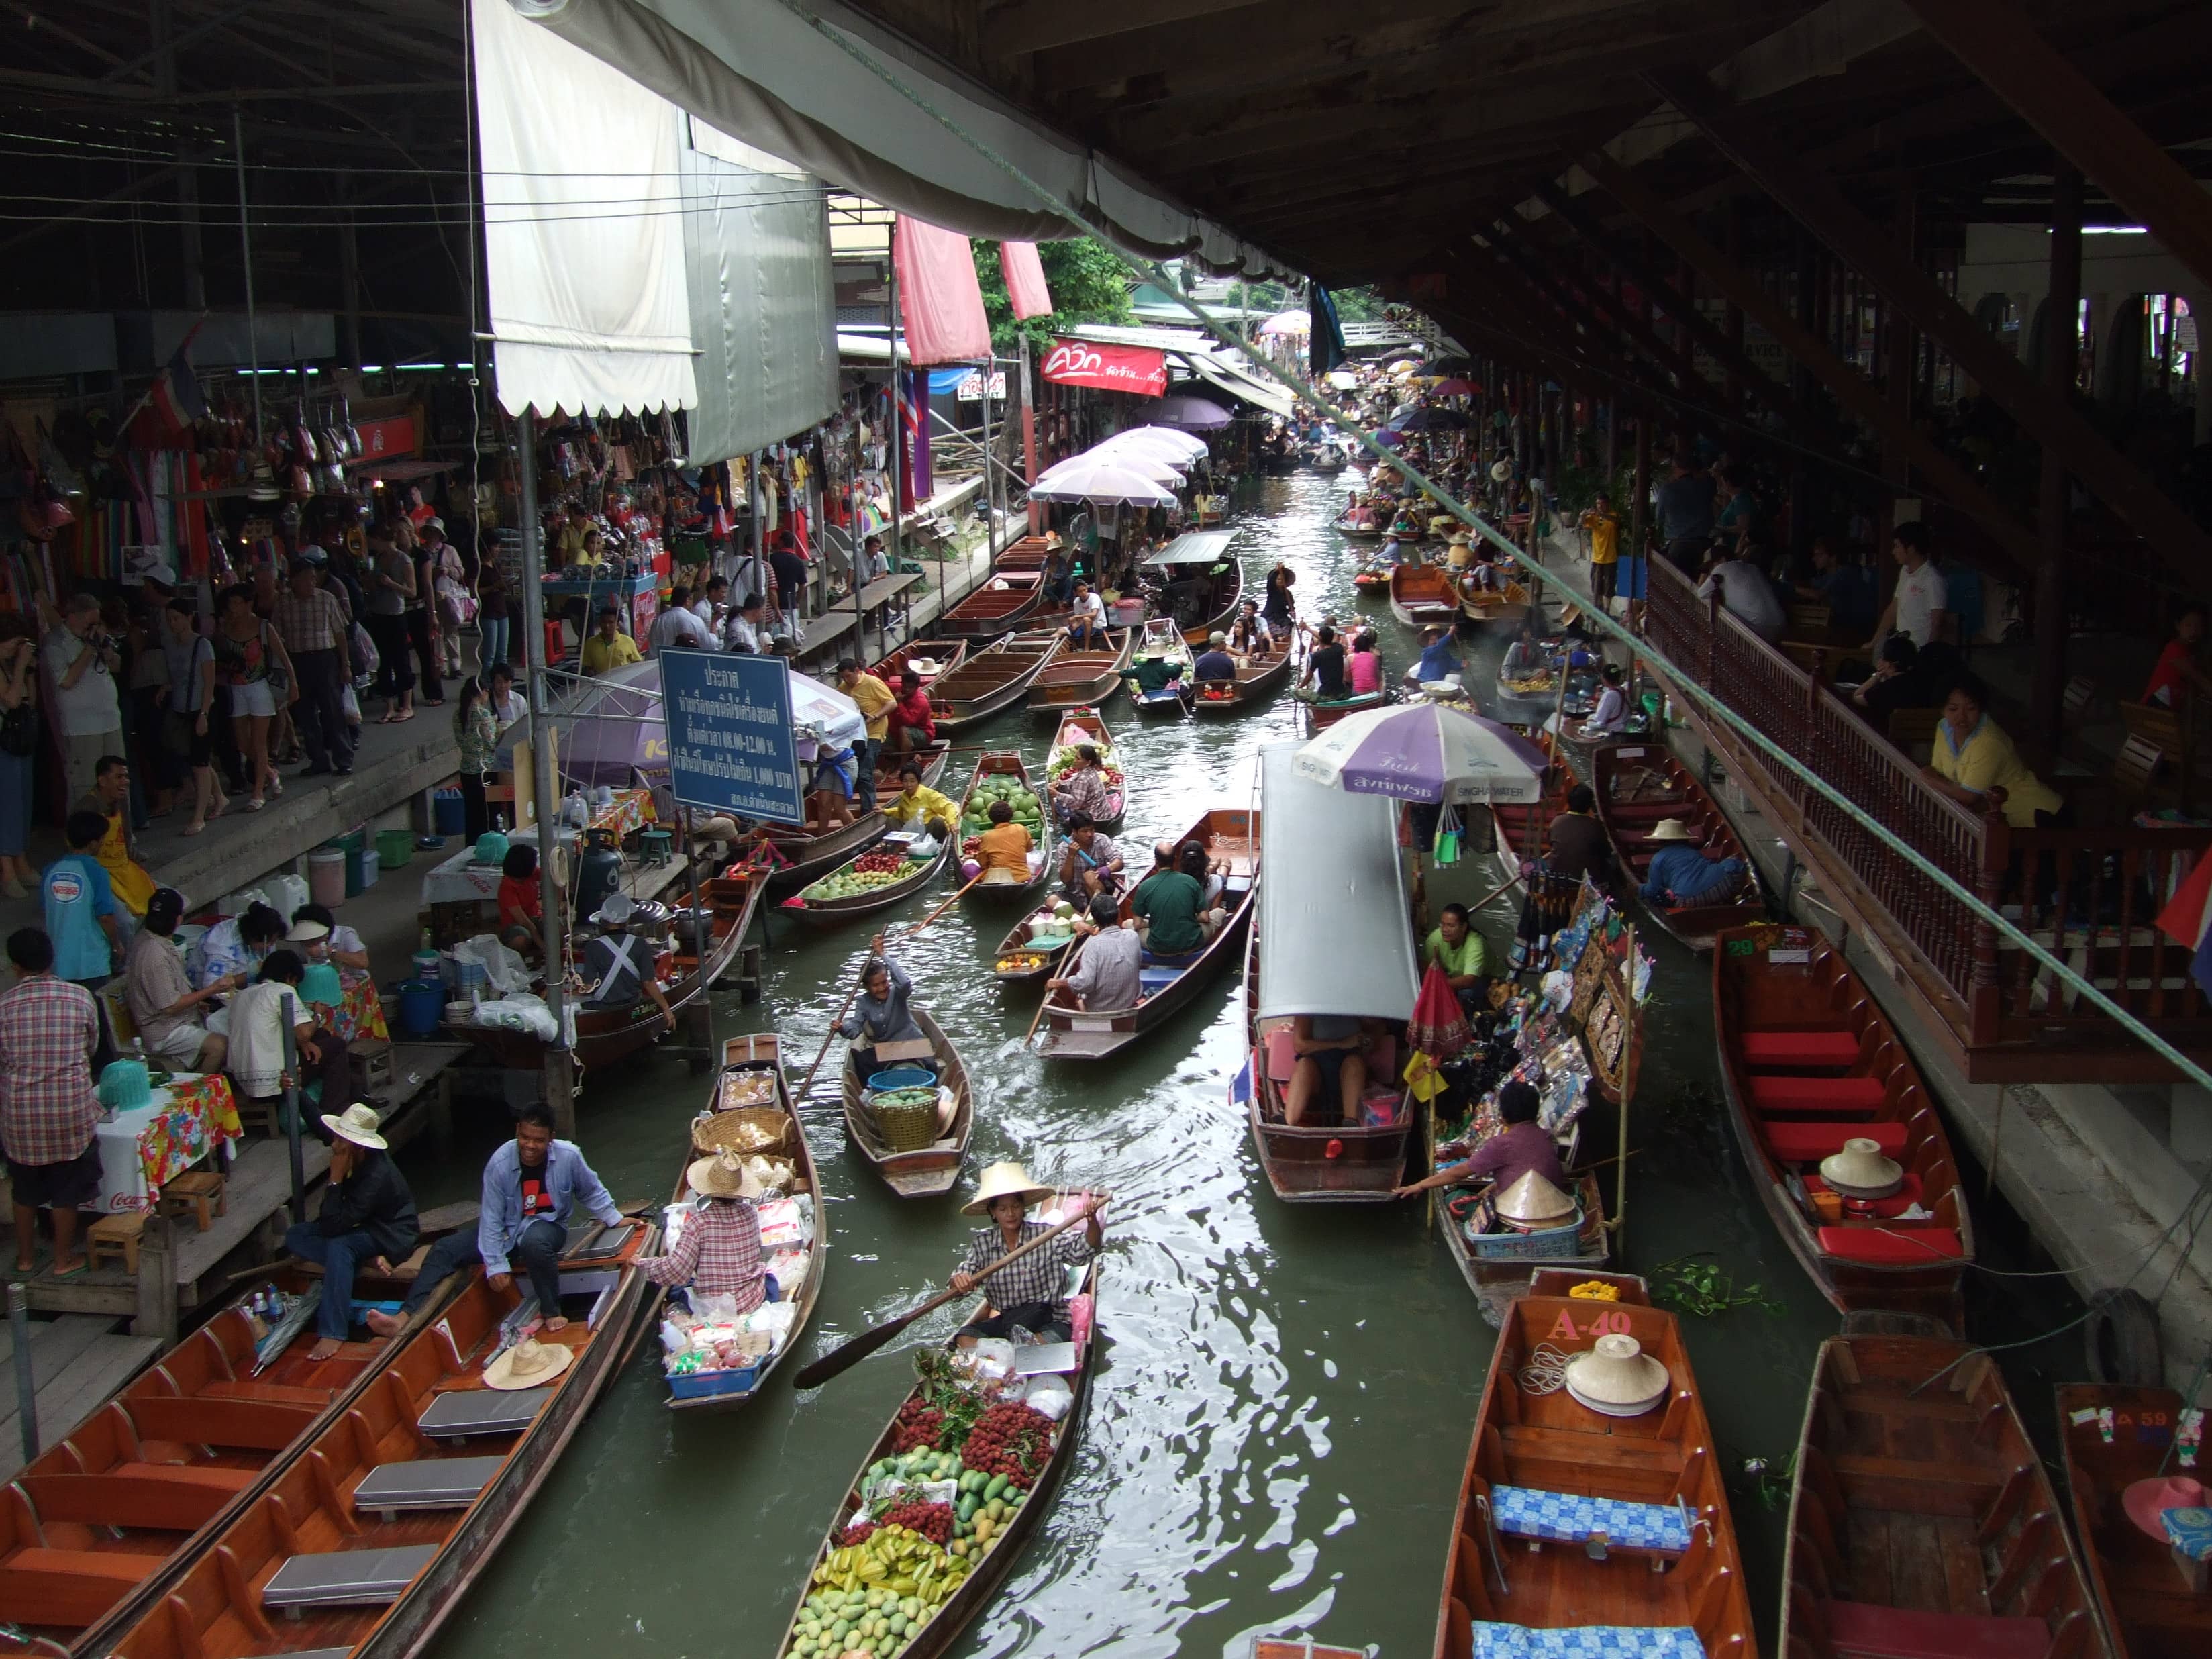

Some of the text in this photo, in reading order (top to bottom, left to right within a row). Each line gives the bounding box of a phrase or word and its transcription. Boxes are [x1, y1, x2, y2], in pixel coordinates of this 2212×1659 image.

[1044, 342, 1102, 375] ควิก
[705, 660, 739, 689] ประกาศ
[678, 689, 778, 725] ห้ามเรือทุกชนิดใช้เครื่องยนต์
[687, 715, 777, 756] ตั้งแต่เวลา 08.00-12.00 น.
[754, 766, 774, 788] 1,000
[775, 771, 793, 789] บาท
[1493, 787, 1524, 797] WATER
[1727, 939, 1754, 956] 29
[2140, 1411, 2168, 1427] 59
